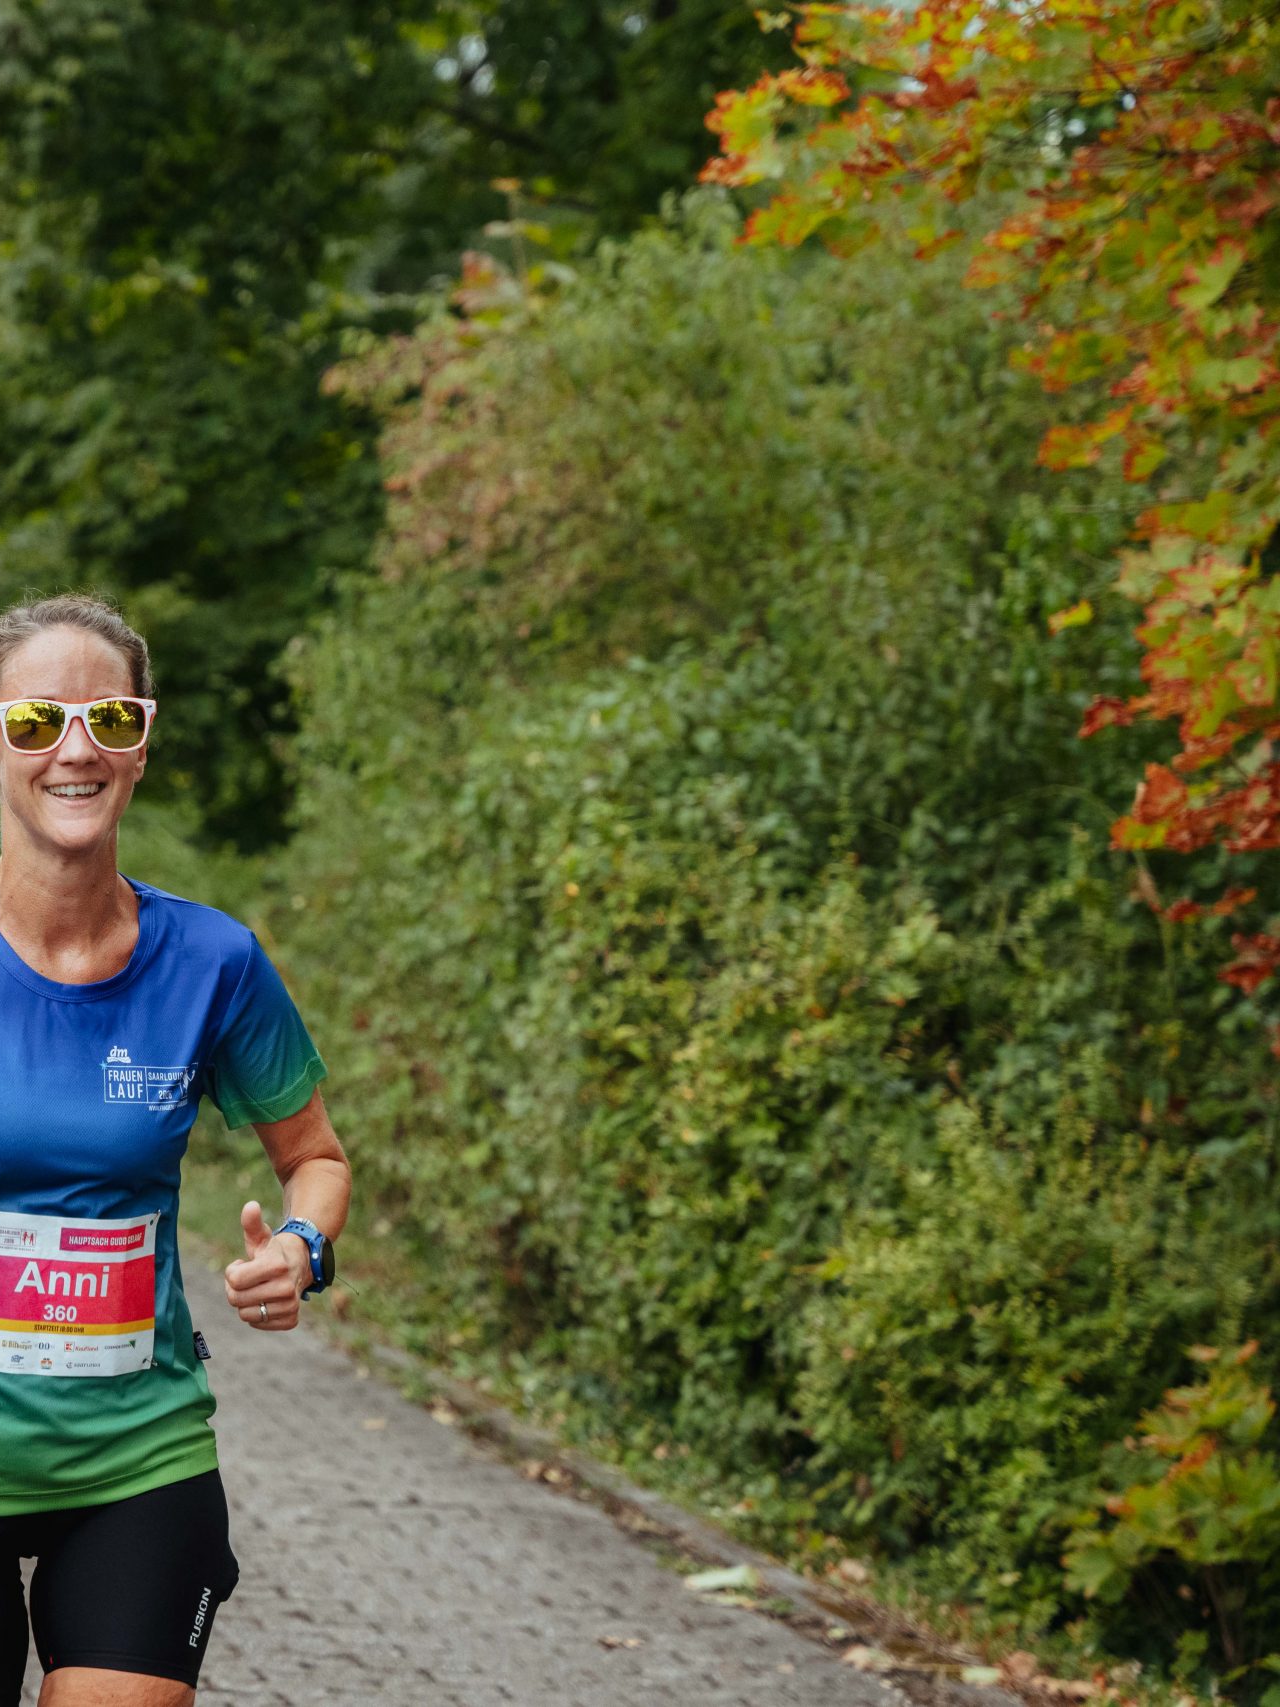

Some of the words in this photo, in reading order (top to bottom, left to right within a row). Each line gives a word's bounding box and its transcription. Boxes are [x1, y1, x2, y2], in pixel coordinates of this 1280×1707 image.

[110, 1046, 128, 1058] dm
[108, 1070, 143, 1082] FRAUEN
[108, 1083, 143, 1099] LAUF
[69, 1236, 109, 1246] HAUPTSACH
[14, 1261, 110, 1298] Anni
[43, 1304, 78, 1322] 360
[189, 1587, 211, 1648] FUSION
